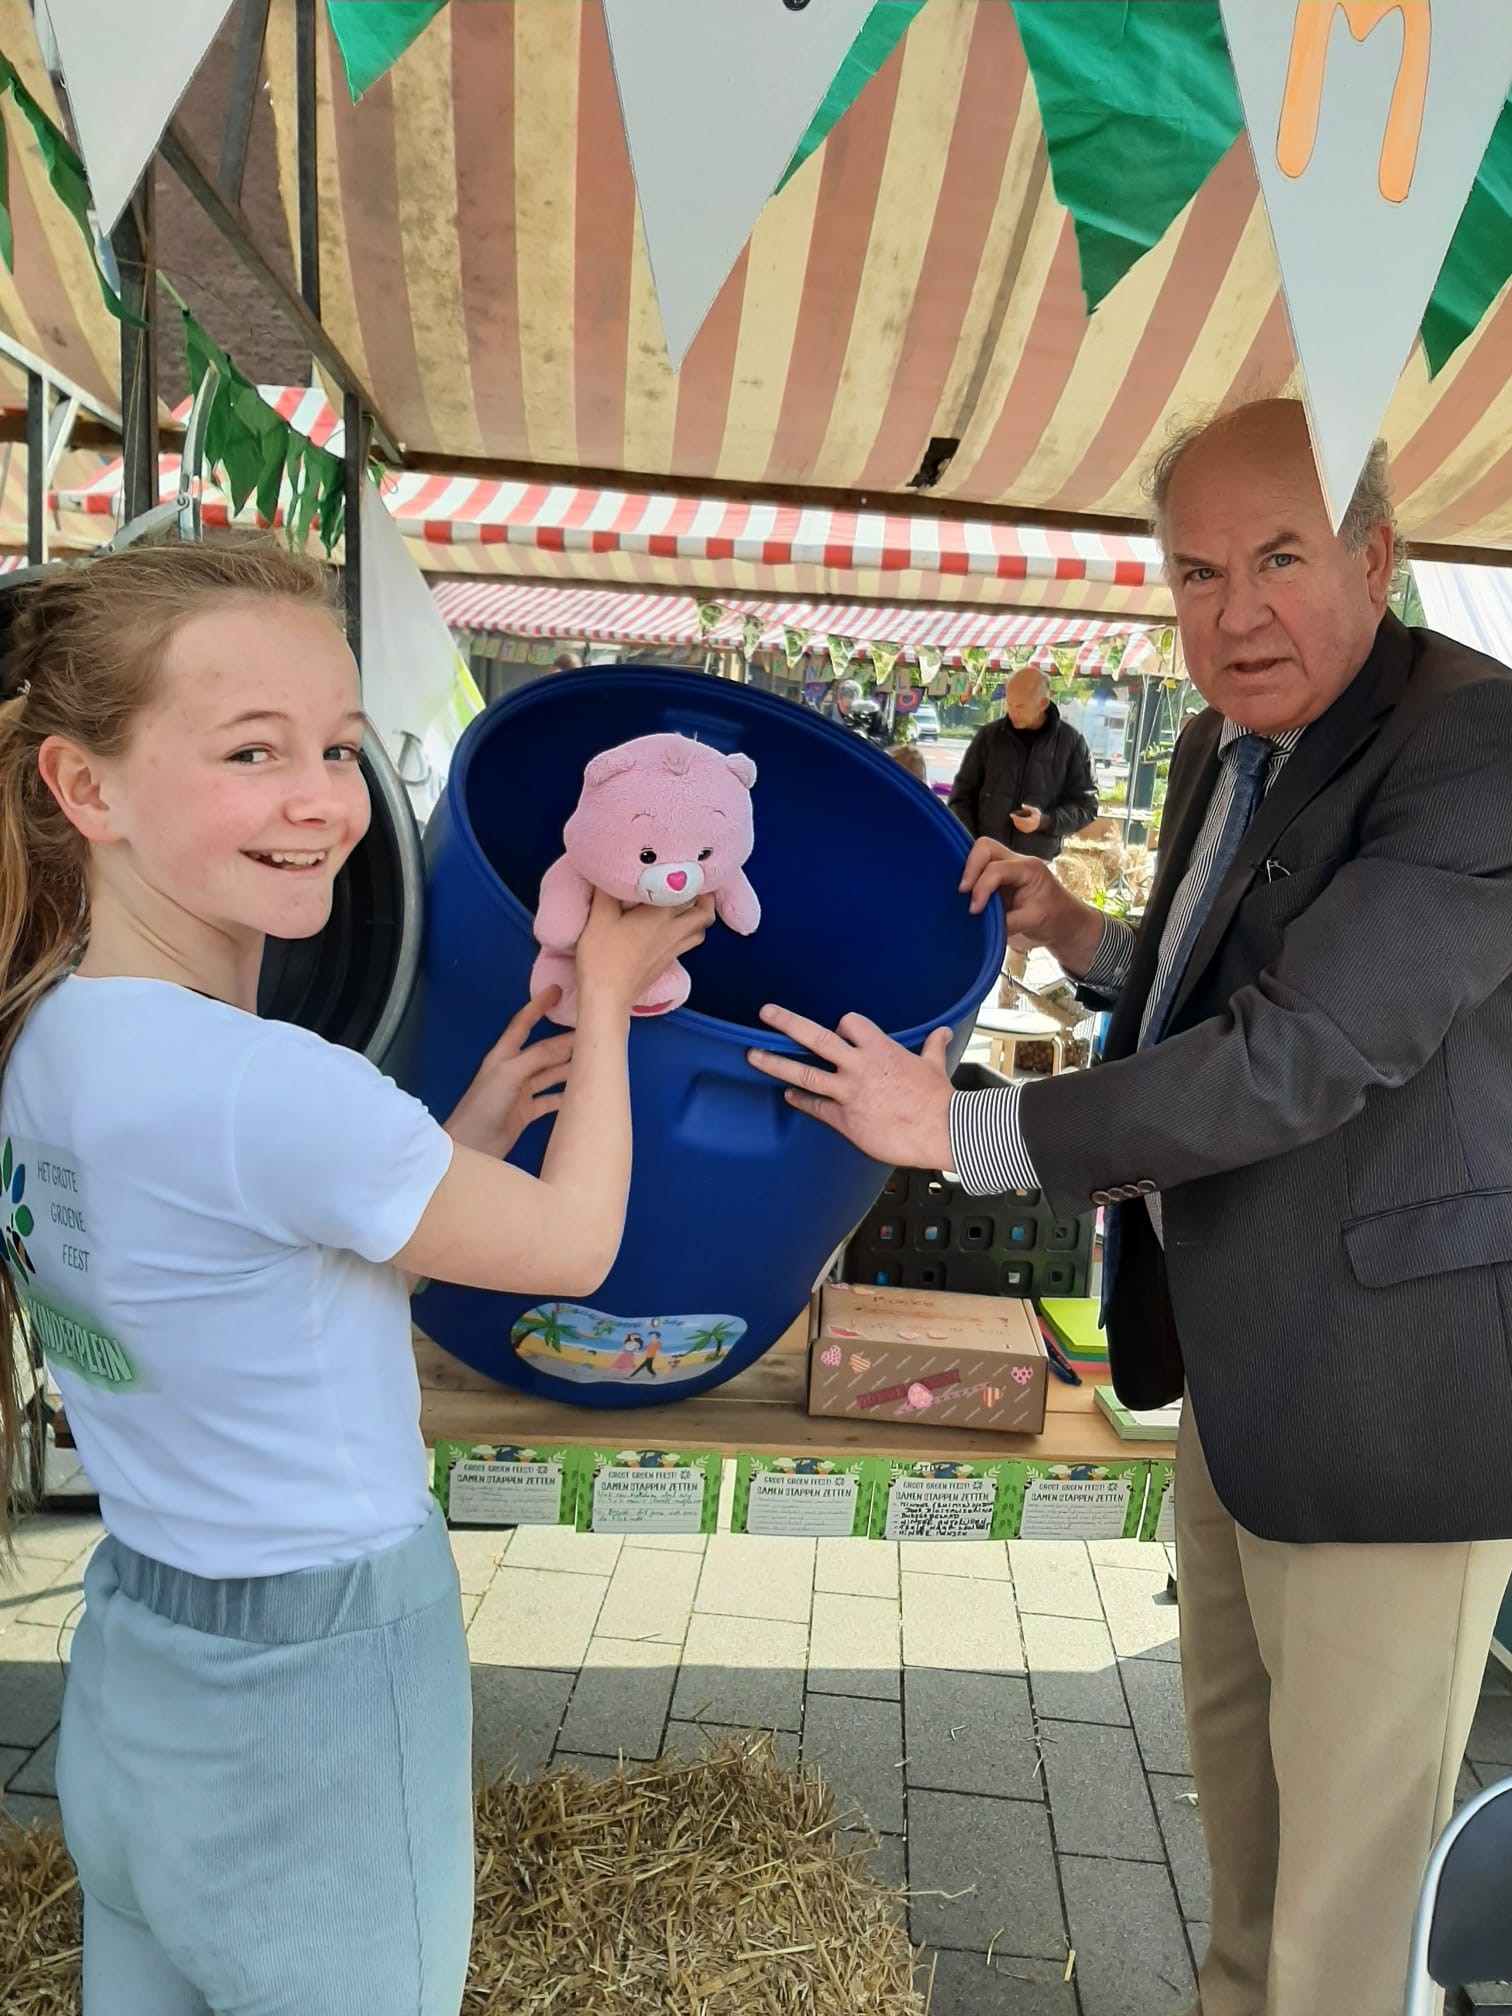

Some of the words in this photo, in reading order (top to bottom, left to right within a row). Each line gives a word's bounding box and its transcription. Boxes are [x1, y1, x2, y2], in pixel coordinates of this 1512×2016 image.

[1275, 0, 1431, 204] M
[37, 1160, 51, 1182] HET
[51, 1165, 79, 1193] GROTE
[50, 1202, 87, 1233] GROENE
[62, 1244, 91, 1273] FEEST
[457, 1474, 485, 1483] SAMEN
[487, 1475, 523, 1485] STAPPEN
[526, 1476, 556, 1486] ZETTEN
[601, 1482, 628, 1491] SAMEN
[630, 1482, 666, 1491] STAPPEN
[668, 1483, 698, 1491] ZETTEN
[756, 1486, 783, 1495] SAMEN
[785, 1487, 820, 1497] STAPPEN
[823, 1488, 852, 1497] ZETTEN
[895, 1492, 923, 1500] SAMEN
[924, 1492, 958, 1501] STAPPEN
[961, 1493, 989, 1501] ZETTEN
[1031, 1492, 1058, 1501] SAMEN
[1059, 1493, 1093, 1502] STAPPEN
[1096, 1493, 1124, 1502] ZETTEN
